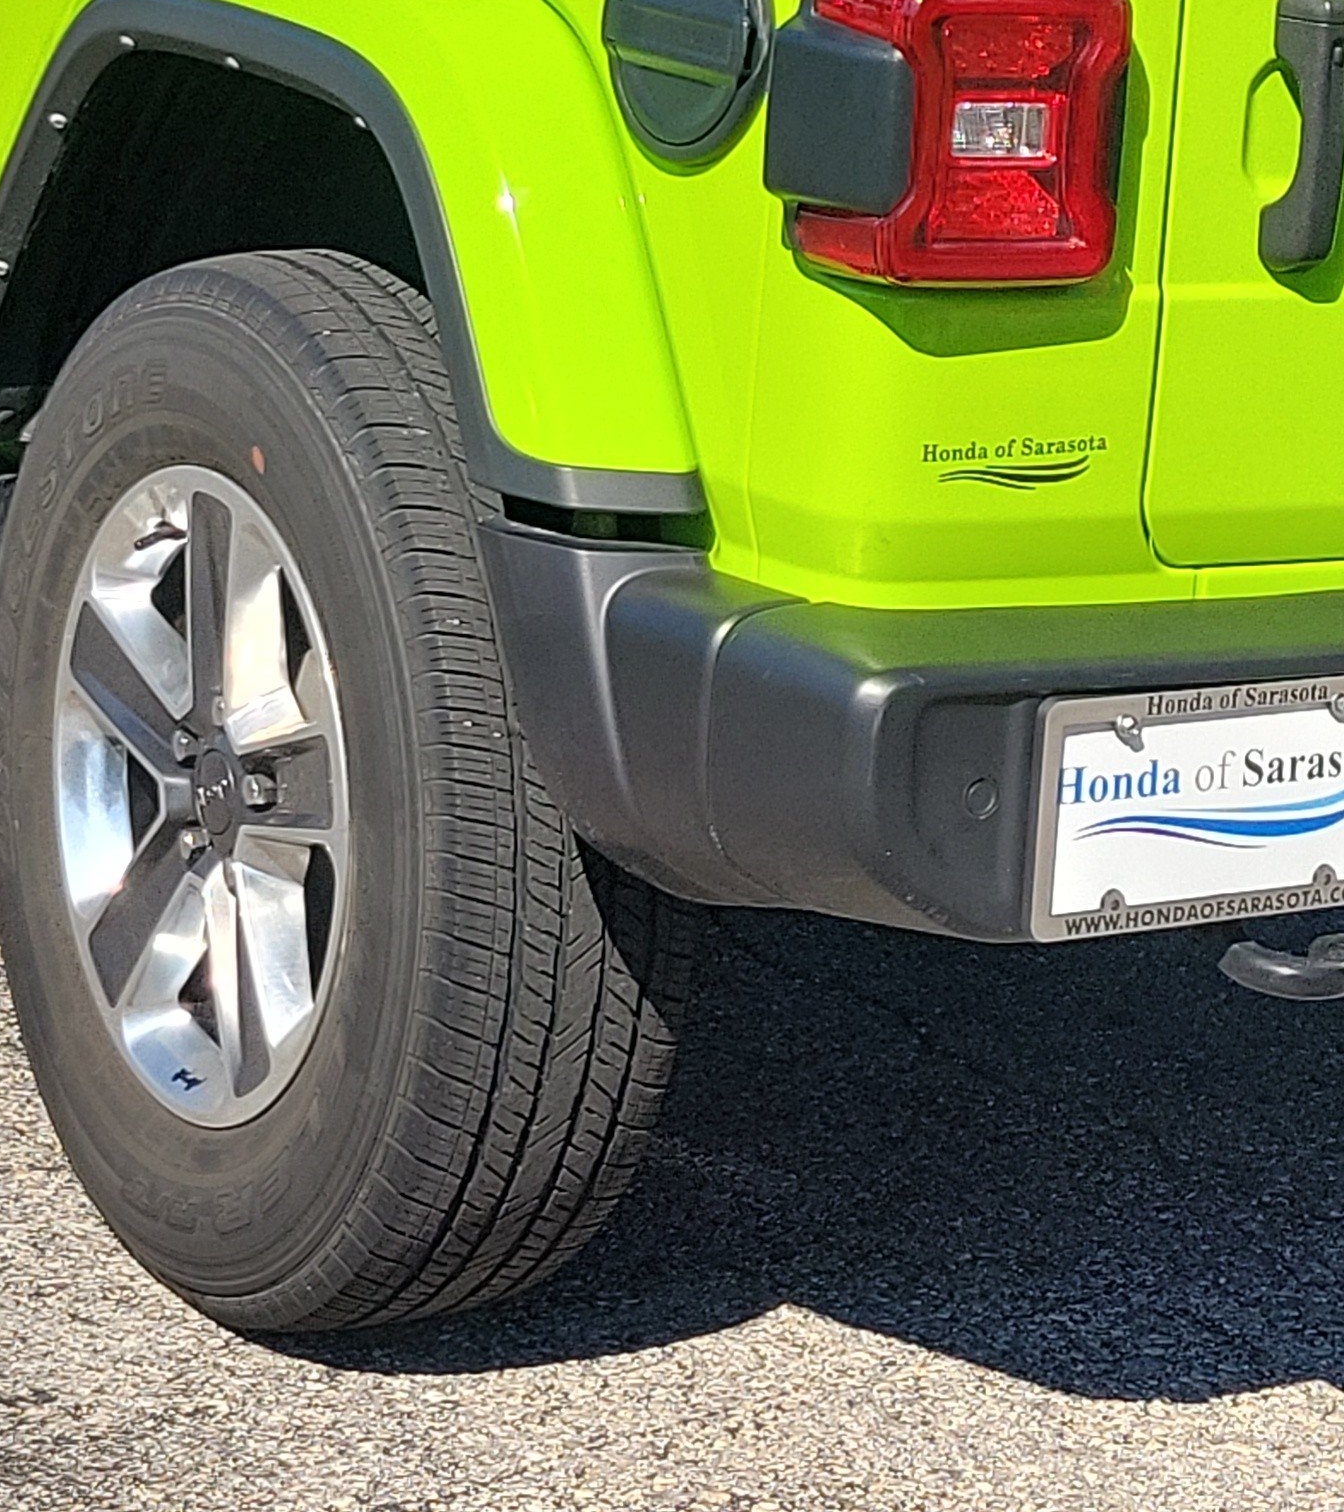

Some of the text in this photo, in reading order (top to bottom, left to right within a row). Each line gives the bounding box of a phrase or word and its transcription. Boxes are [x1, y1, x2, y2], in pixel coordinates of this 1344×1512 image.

[922, 435, 1108, 463] Honda of Sarasota
[1147, 683, 1329, 717] Honda of Sarasota
[1057, 759, 1181, 806] Honda
[1194, 750, 1236, 792] of
